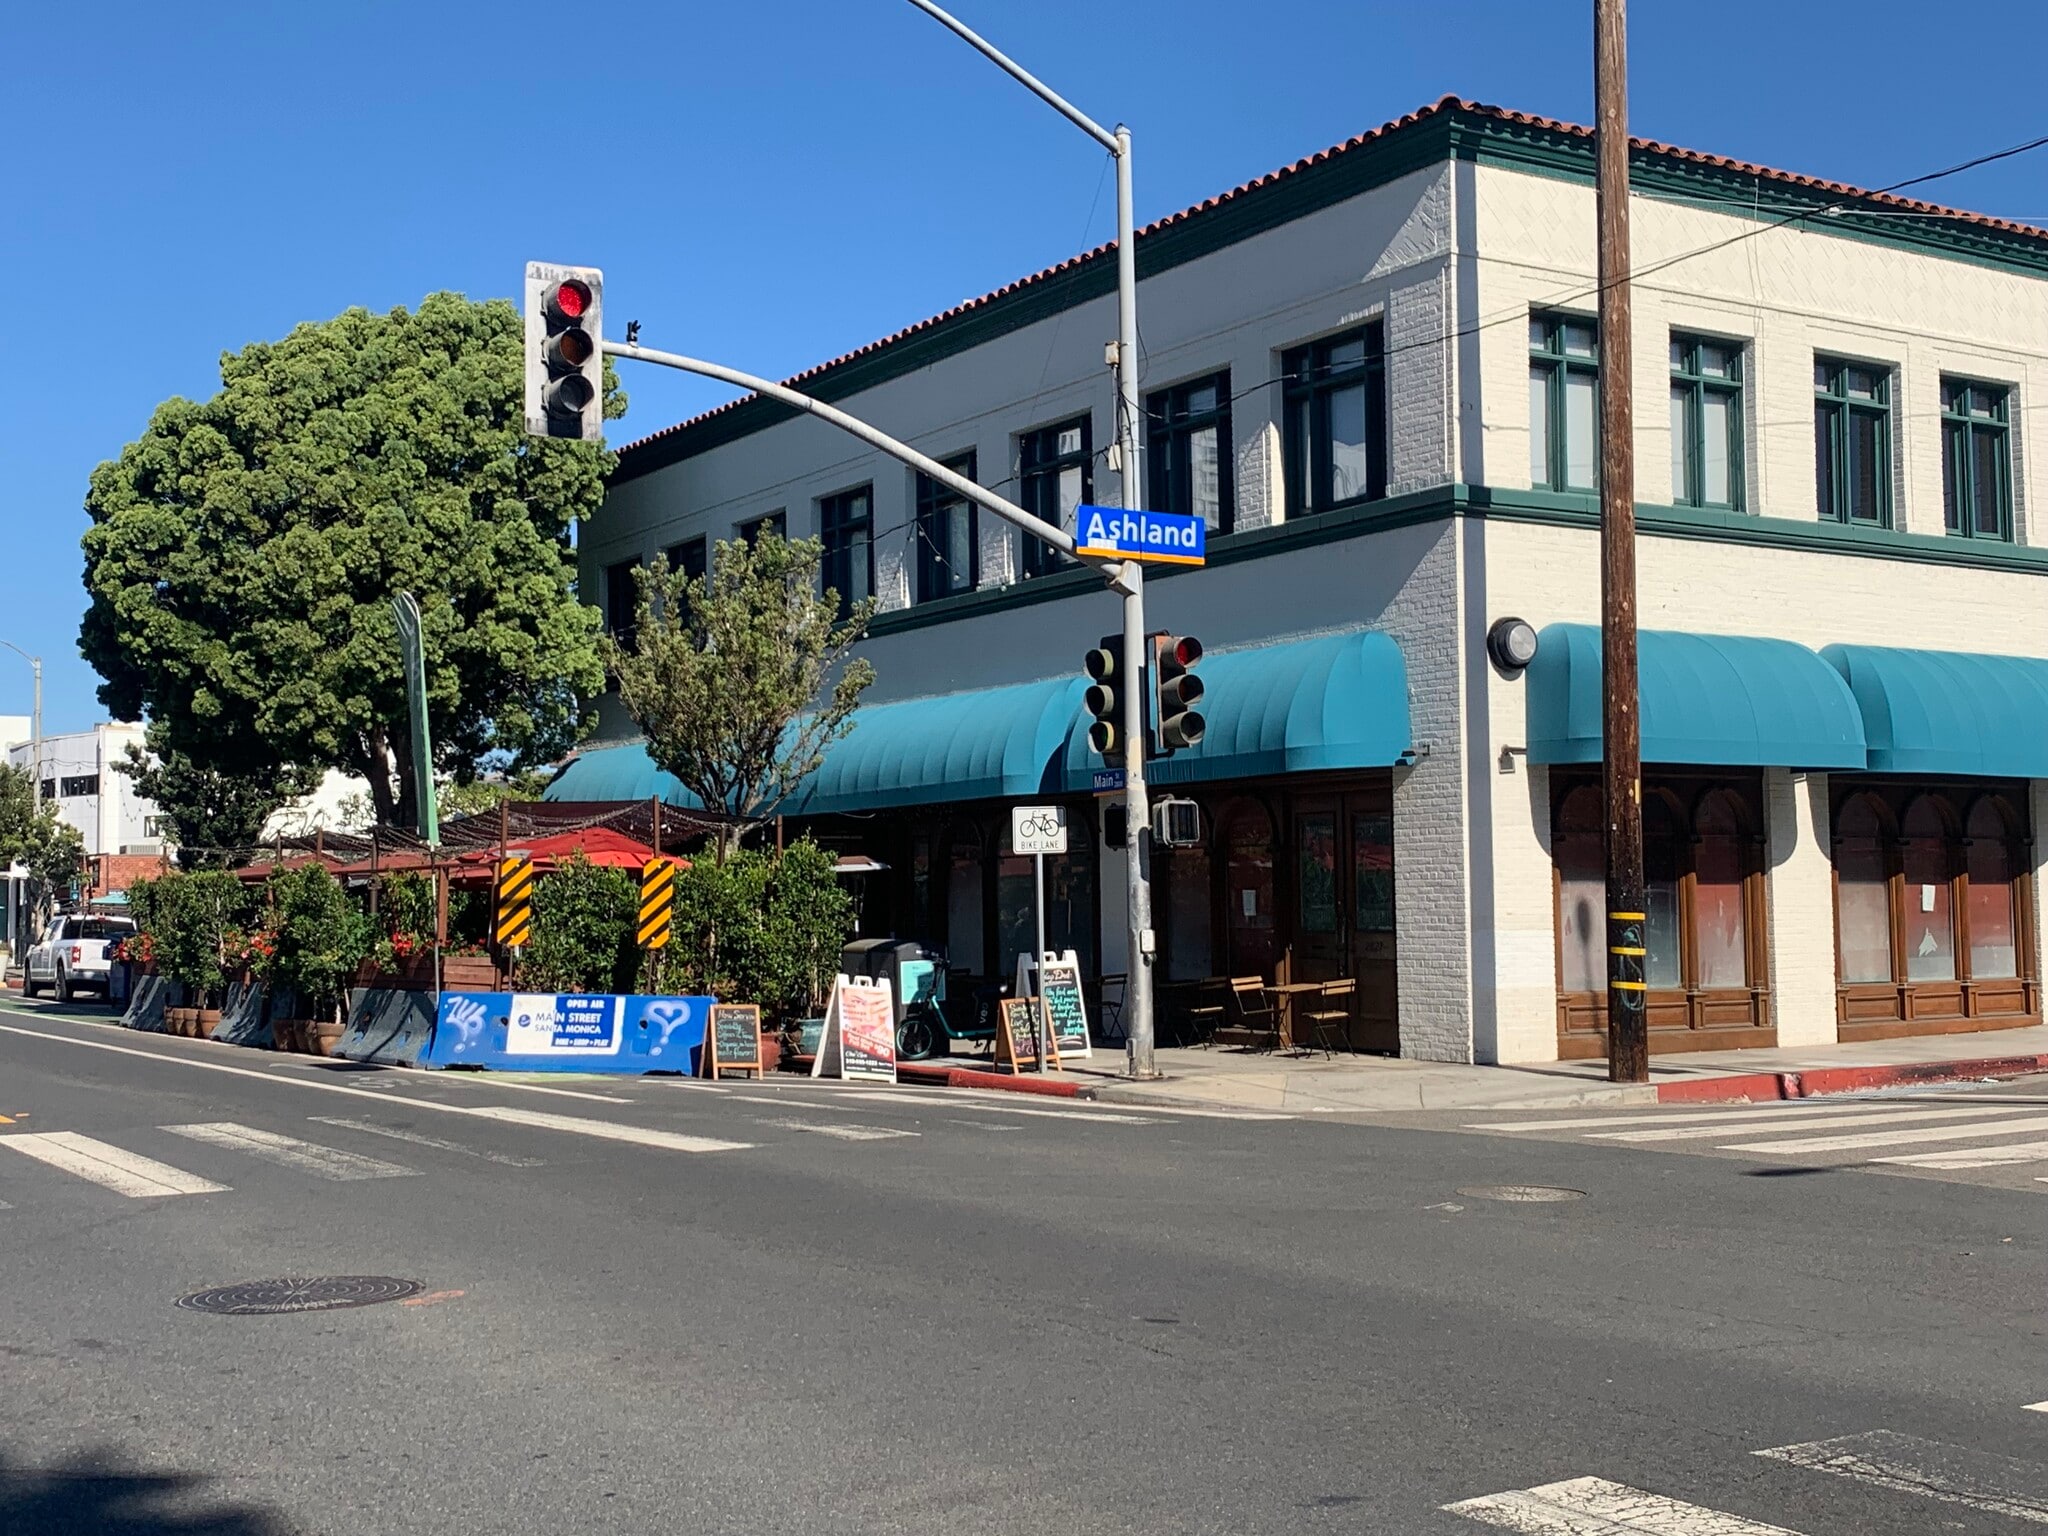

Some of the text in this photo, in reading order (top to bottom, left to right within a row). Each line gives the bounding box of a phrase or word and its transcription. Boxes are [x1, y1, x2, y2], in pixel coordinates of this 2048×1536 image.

[1086, 512, 1197, 548] Ashland
[1094, 773, 1114, 789] Main
[1021, 840, 1059, 850] BIKE LANE
[566, 999, 605, 1009] OPEN AIR
[535, 1009, 602, 1024] MAIN STREET
[534, 1024, 602, 1035] SANTA MONICA
[593, 1039, 609, 1047] PLAY
